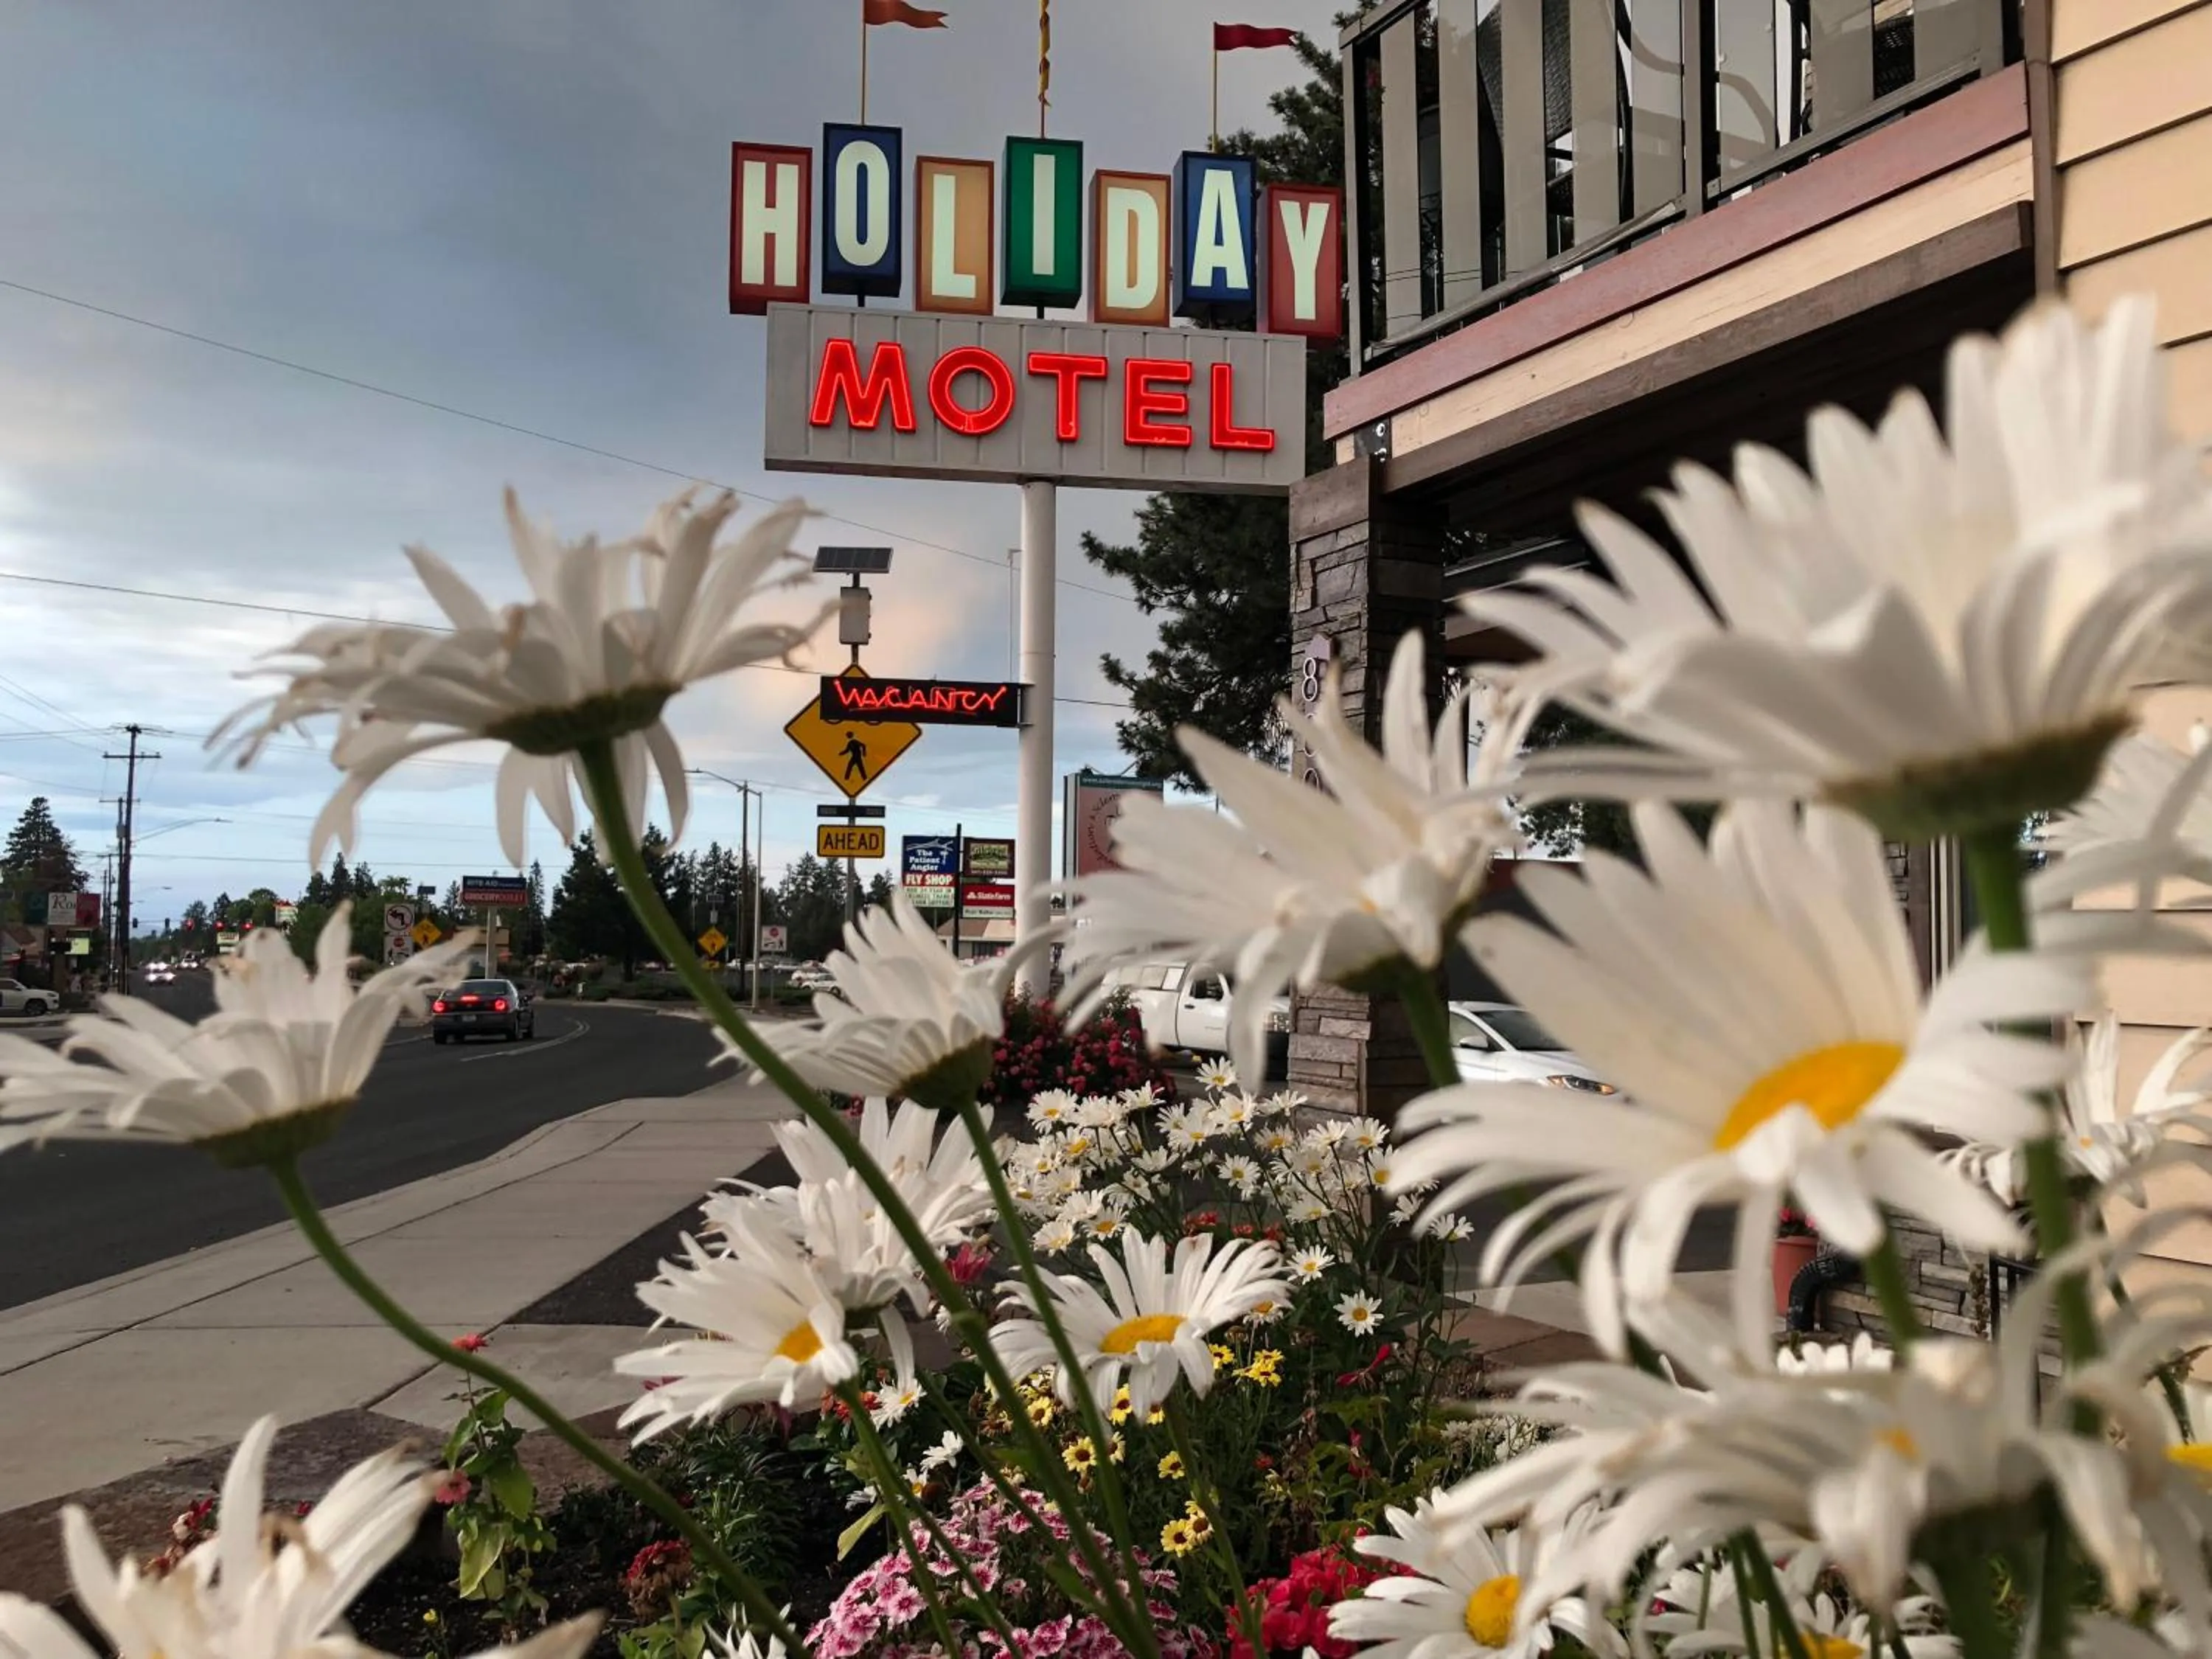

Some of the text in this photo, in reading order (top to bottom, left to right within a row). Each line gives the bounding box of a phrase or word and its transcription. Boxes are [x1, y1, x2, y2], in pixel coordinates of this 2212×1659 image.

[740, 139, 1329, 320] HOLIDAY
[809, 338, 1275, 452] MOTEL
[833, 678, 1007, 710] VACANCY
[822, 832, 880, 850] AHEAD
[905, 874, 953, 885] FLY SHOP
[910, 863, 939, 872] Angler
